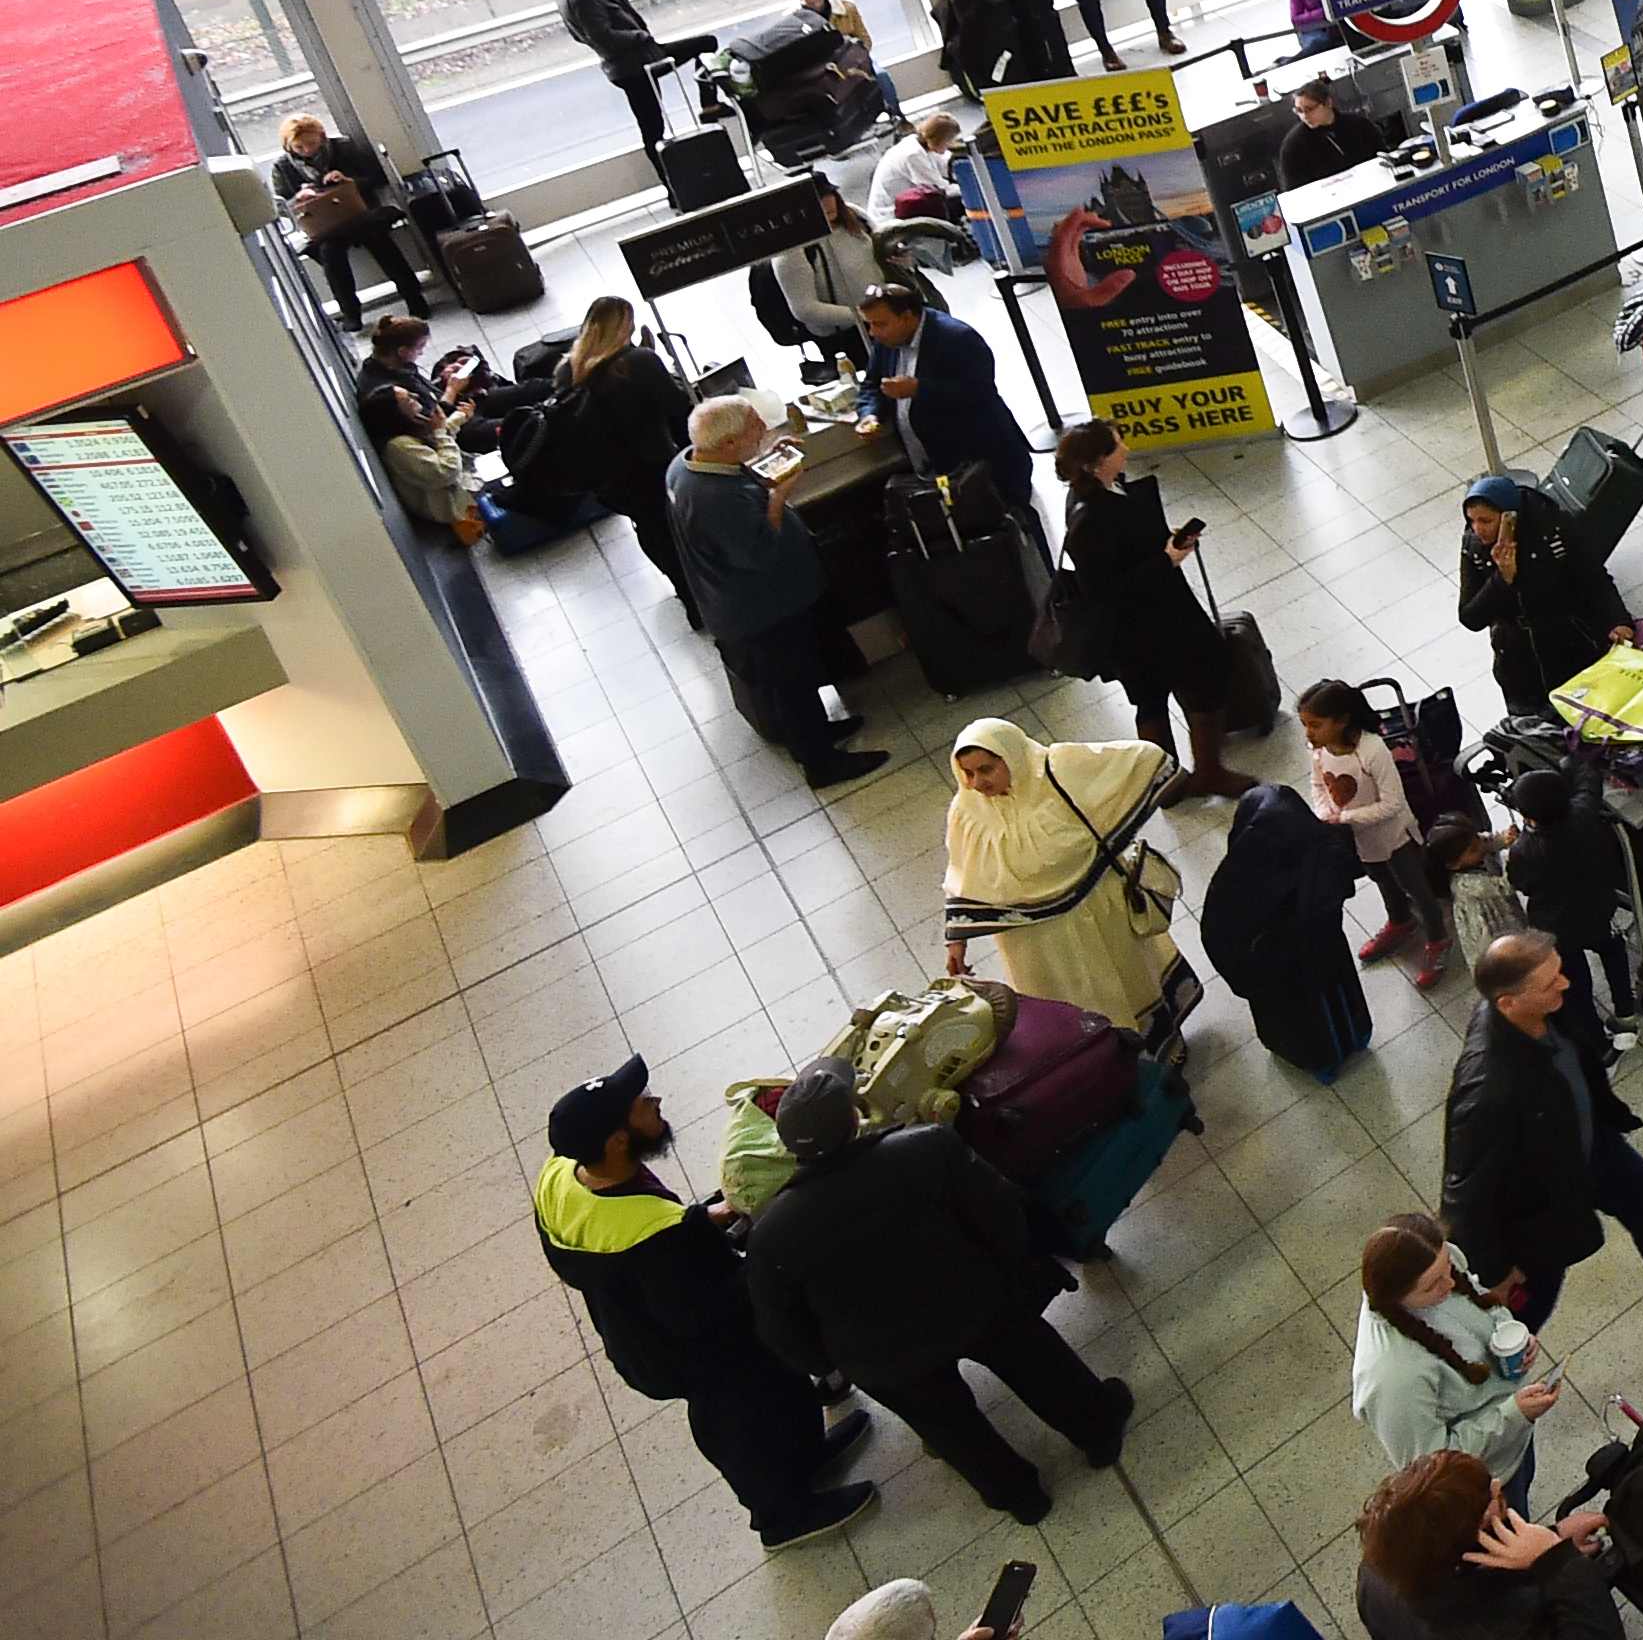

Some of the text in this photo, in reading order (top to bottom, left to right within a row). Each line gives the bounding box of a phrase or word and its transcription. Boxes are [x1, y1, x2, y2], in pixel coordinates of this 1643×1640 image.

[1001, 91, 1169, 129] SAVE £££'s
[1010, 112, 1174, 145] ON ATTRACTIONS
[1015, 144, 1049, 157] WITH
[1053, 138, 1075, 151] THE
[1079, 134, 1137, 150] LONDON
[1392, 157, 1516, 214] TRANSPORT FOR LONDON
[1096, 244, 1151, 260] LONDON
[1101, 309, 1202, 329] FREE entry into over
[1136, 321, 1189, 336] attractions
[1106, 332, 1213, 354] FAST TRACK entry to
[1151, 345, 1202, 360] attractions
[1154, 357, 1208, 374] guidebook
[1111, 385, 1246, 420] BUY YOUR
[1117, 405, 1254, 439] PASS HERE
